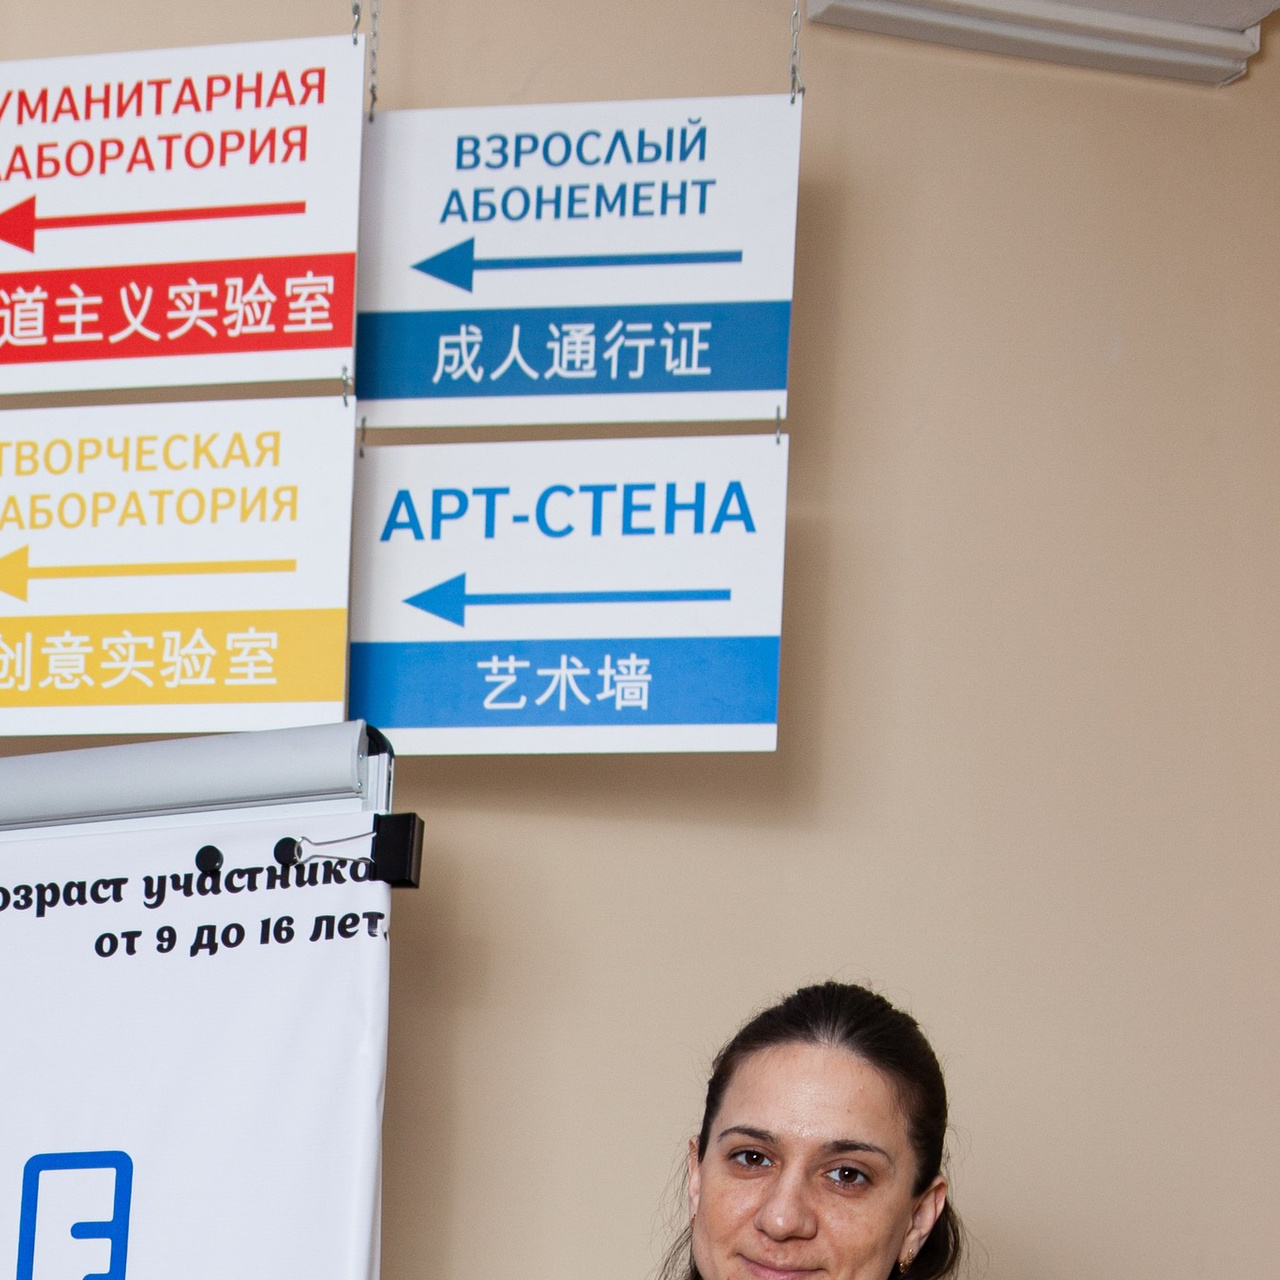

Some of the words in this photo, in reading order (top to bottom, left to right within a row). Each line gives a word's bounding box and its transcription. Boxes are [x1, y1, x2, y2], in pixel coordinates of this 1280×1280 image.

[455, 116, 708, 171] ВЗРОСЛЫЙ
[439, 179, 717, 225] АБОНЕМЕНТ
[431, 319, 713, 385] 成人通行证
[380, 479, 758, 543] АРТ-СТЕНА
[477, 652, 654, 712] 艺术墙
[142, 856, 372, 909] участнико
[94, 929, 143, 958] от
[156, 925, 178, 954] 9
[190, 921, 246, 957] до
[260, 914, 295, 945] 16
